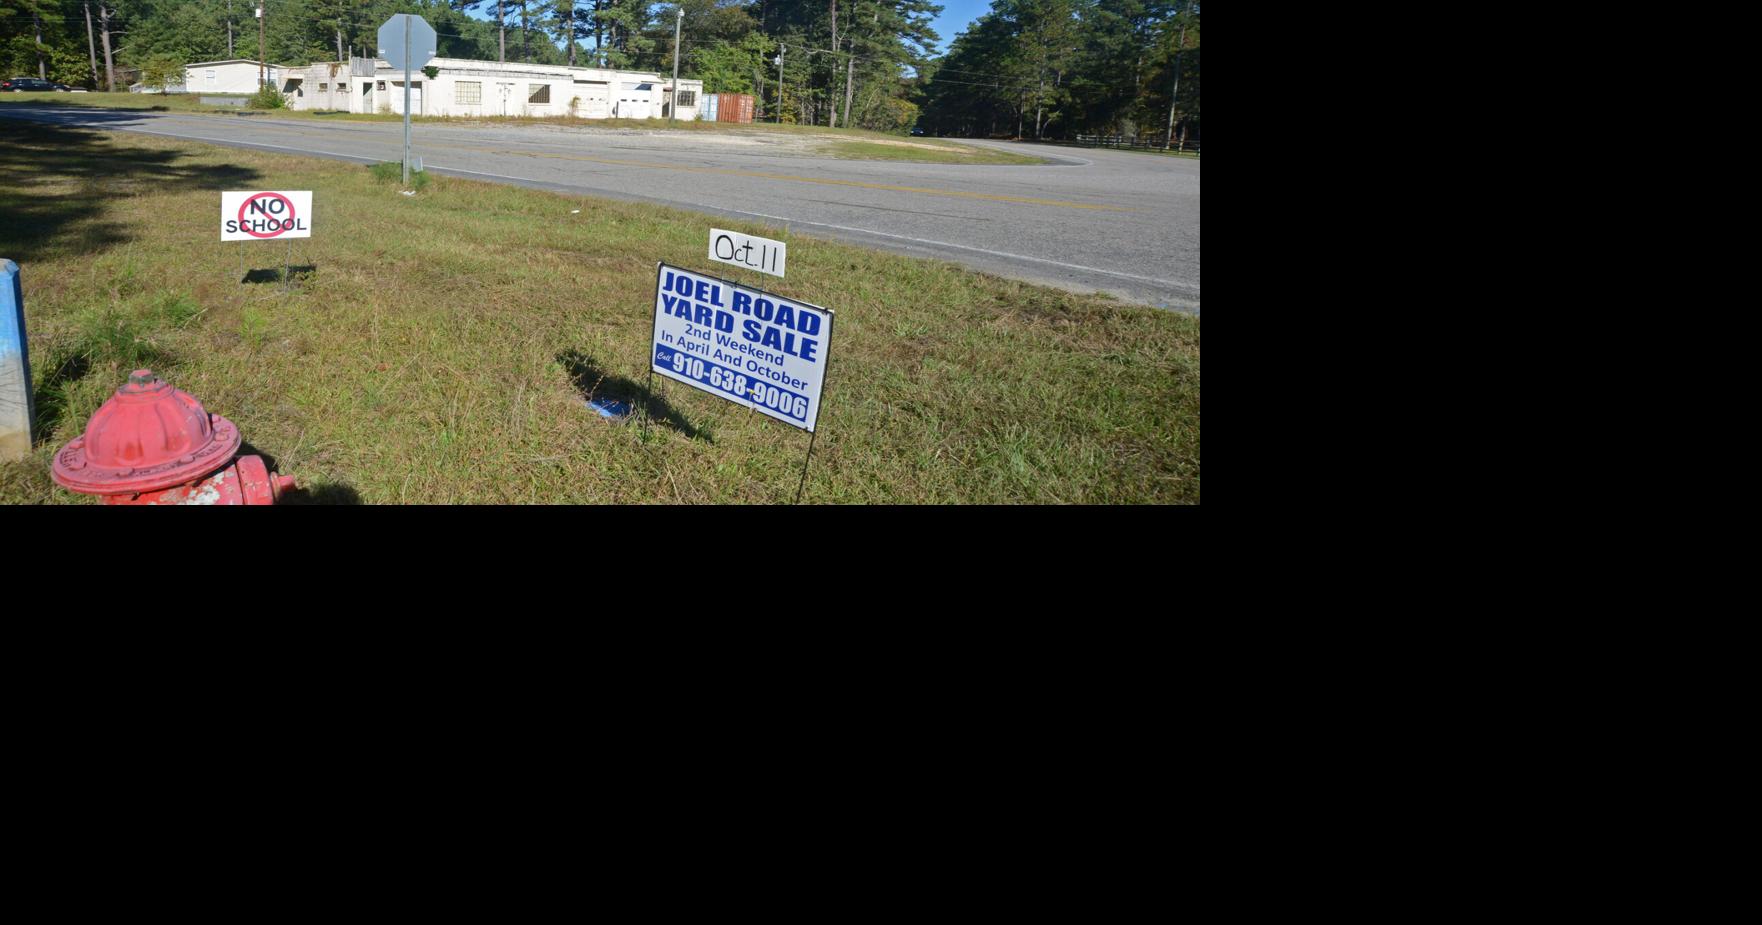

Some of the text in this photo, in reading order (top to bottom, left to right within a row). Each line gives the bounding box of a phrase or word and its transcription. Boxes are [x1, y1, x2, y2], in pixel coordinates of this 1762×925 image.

[226, 218, 307, 233] SCHOOL
[250, 199, 285, 215] NO
[661, 293, 818, 363] YARD SALE
[662, 271, 821, 336] JOEL ROAD
[661, 330, 808, 391] In April And October
[685, 323, 784, 367] 2nd Weekend
[656, 351, 807, 419] Call 910-638-9006
